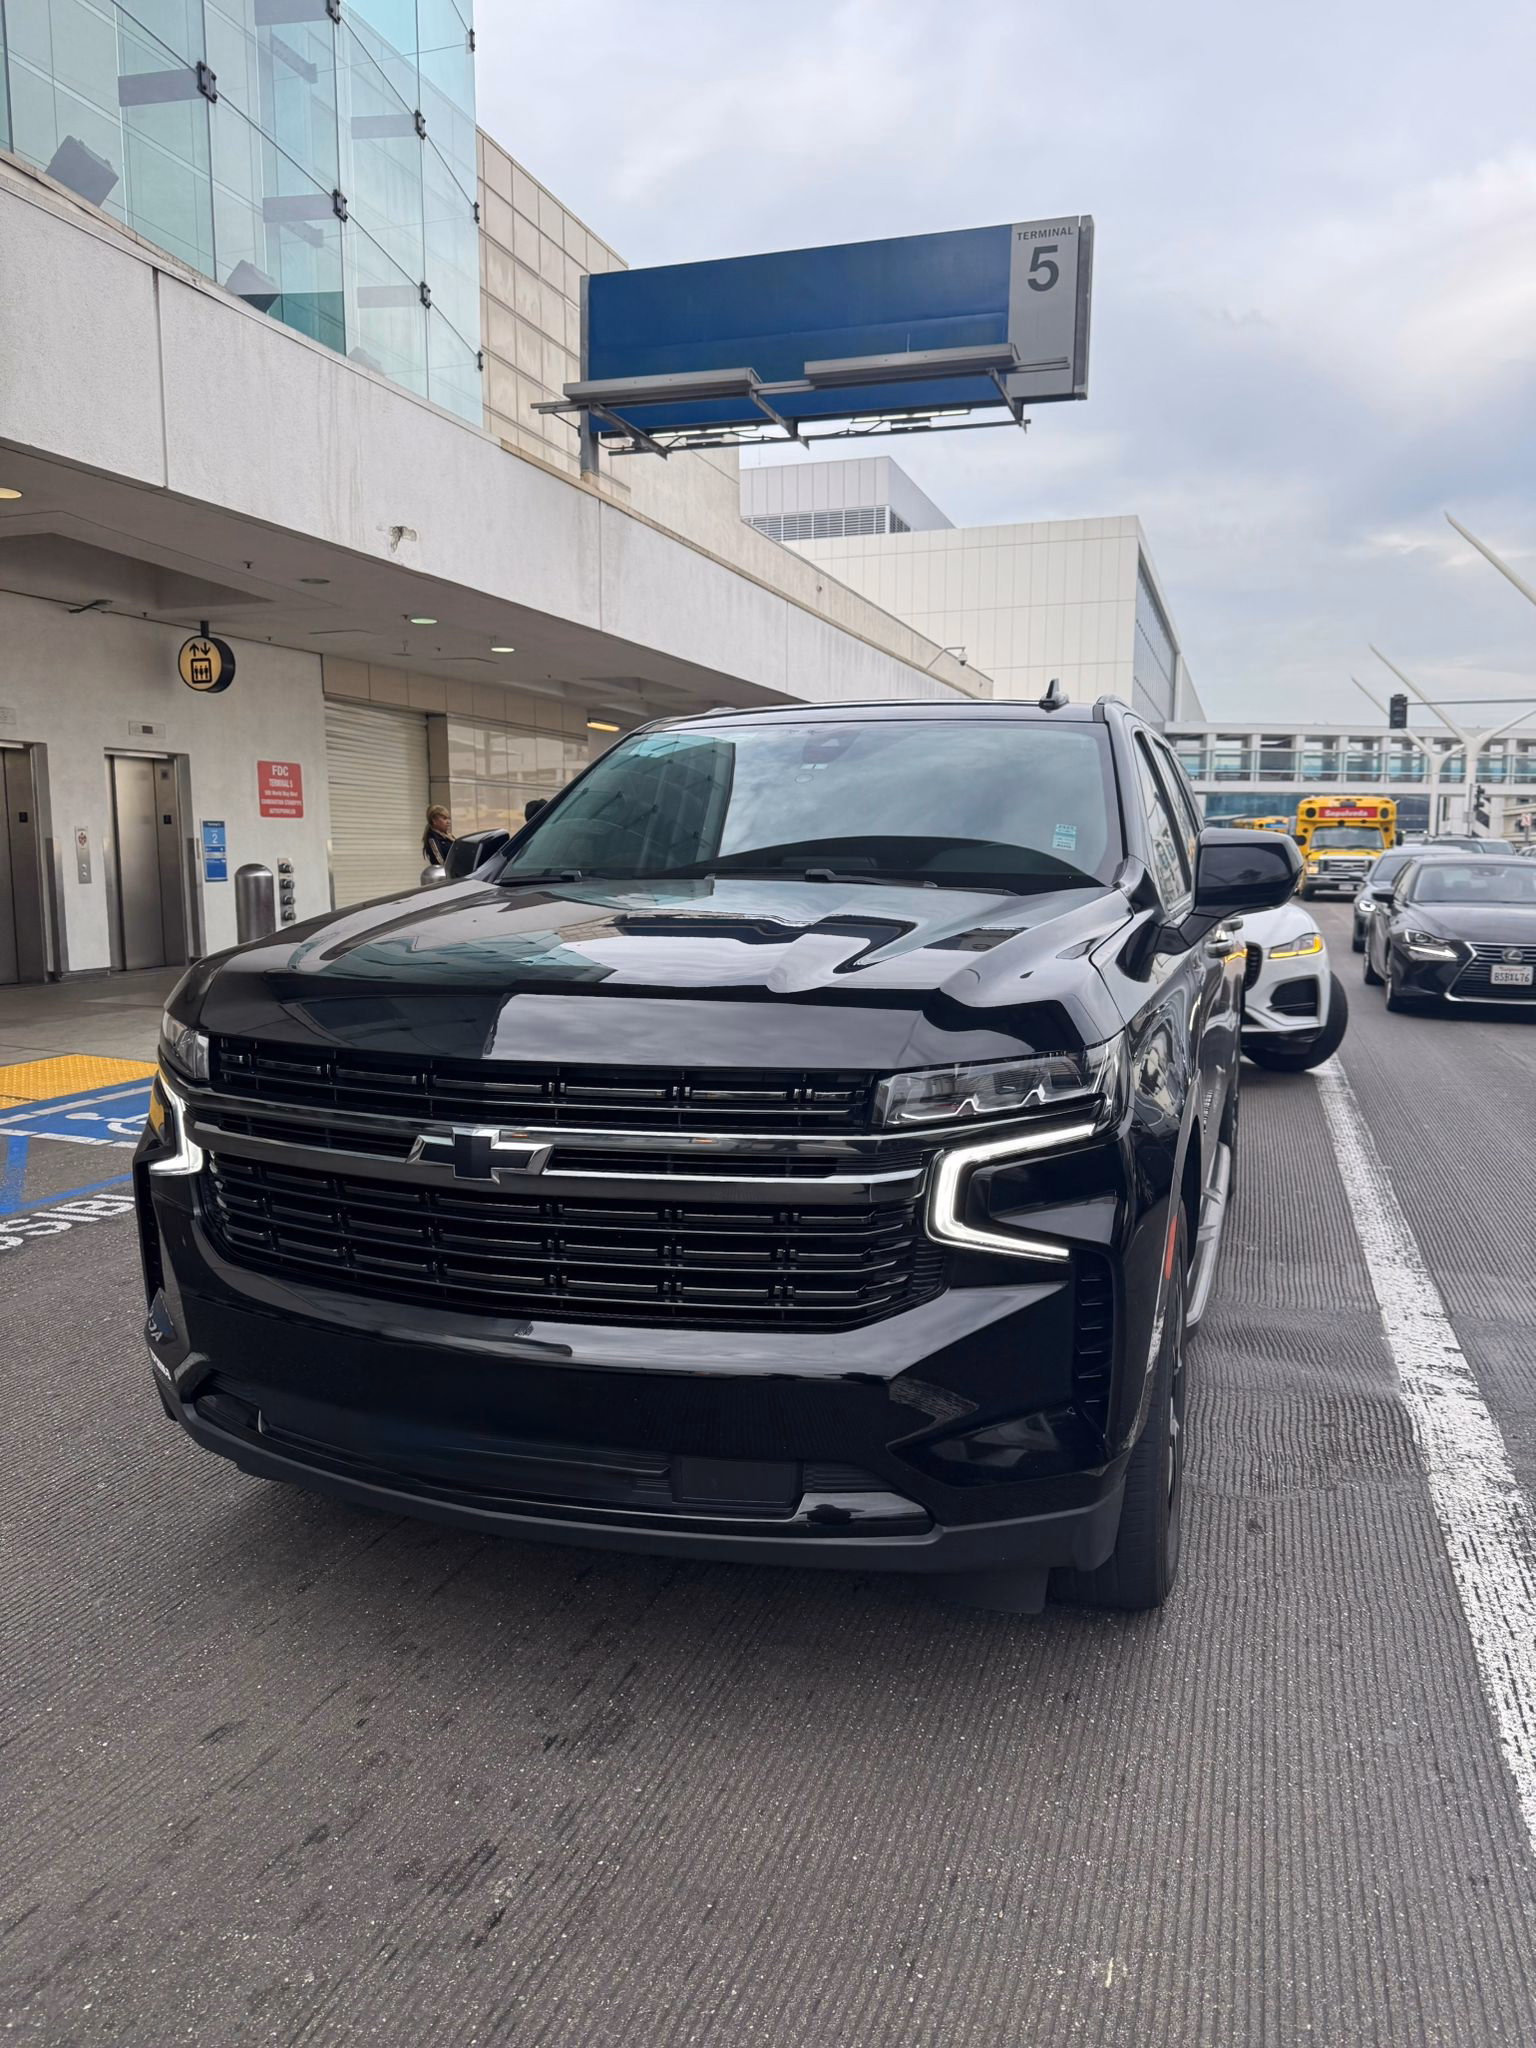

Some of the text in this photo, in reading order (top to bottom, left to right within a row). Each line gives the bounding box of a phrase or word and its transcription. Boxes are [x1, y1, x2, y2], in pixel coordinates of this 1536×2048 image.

[1017, 226, 1074, 241] TERMINAL
[1028, 245, 1059, 292] 5
[272, 765, 289, 776] FDC
[1325, 809, 1369, 818] Sepulveda
[212, 833, 218, 843] 2
